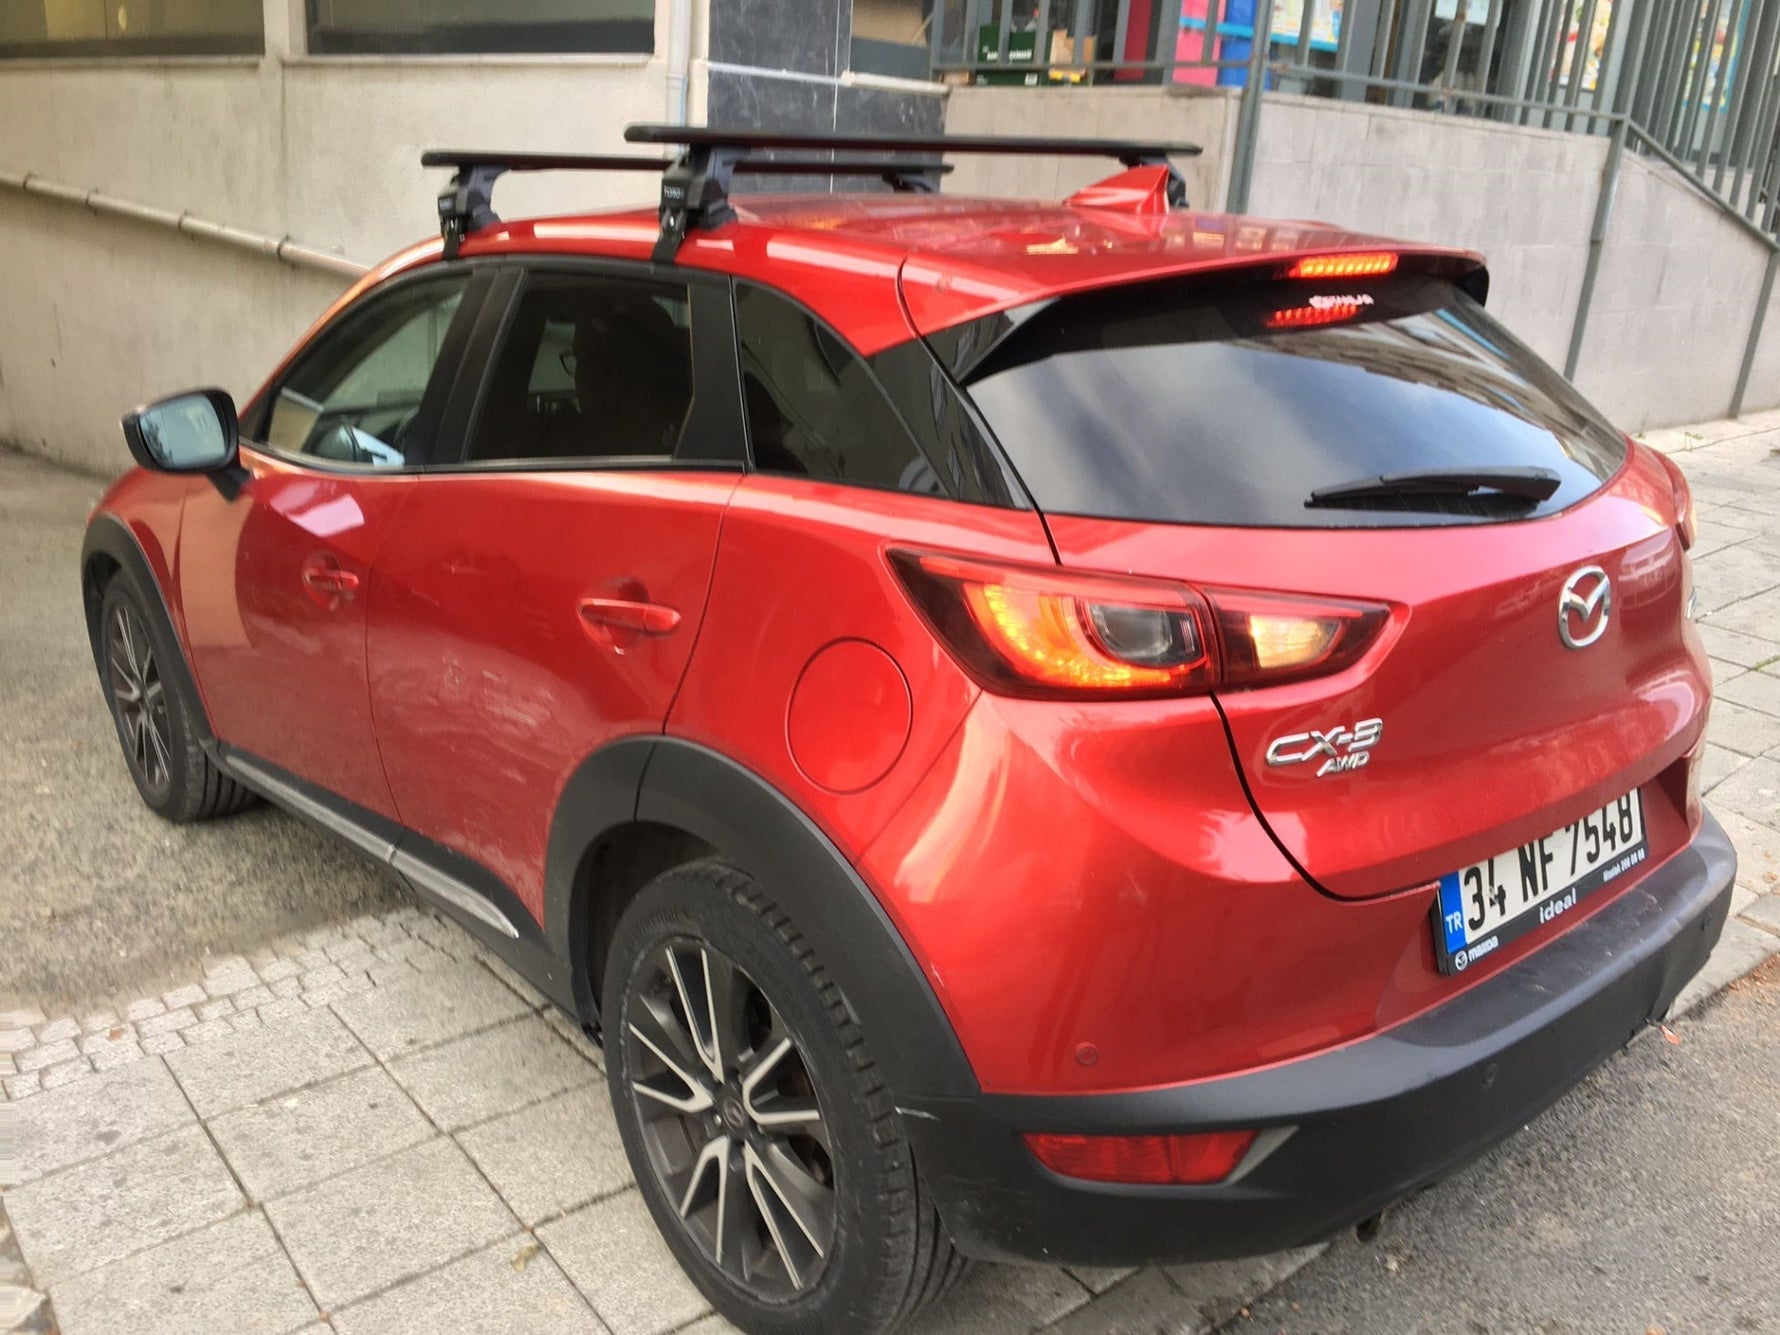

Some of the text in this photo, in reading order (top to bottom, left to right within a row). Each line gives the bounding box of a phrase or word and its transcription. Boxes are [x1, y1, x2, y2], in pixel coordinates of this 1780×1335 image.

[1265, 716, 1384, 766] CX-3
[1315, 750, 1371, 778] AWD
[1464, 859, 1506, 931] 34
[1517, 836, 1554, 903] NF
[1566, 793, 1633, 877] 7548
[1445, 910, 1464, 935] TR
[1540, 887, 1576, 924] ideal
